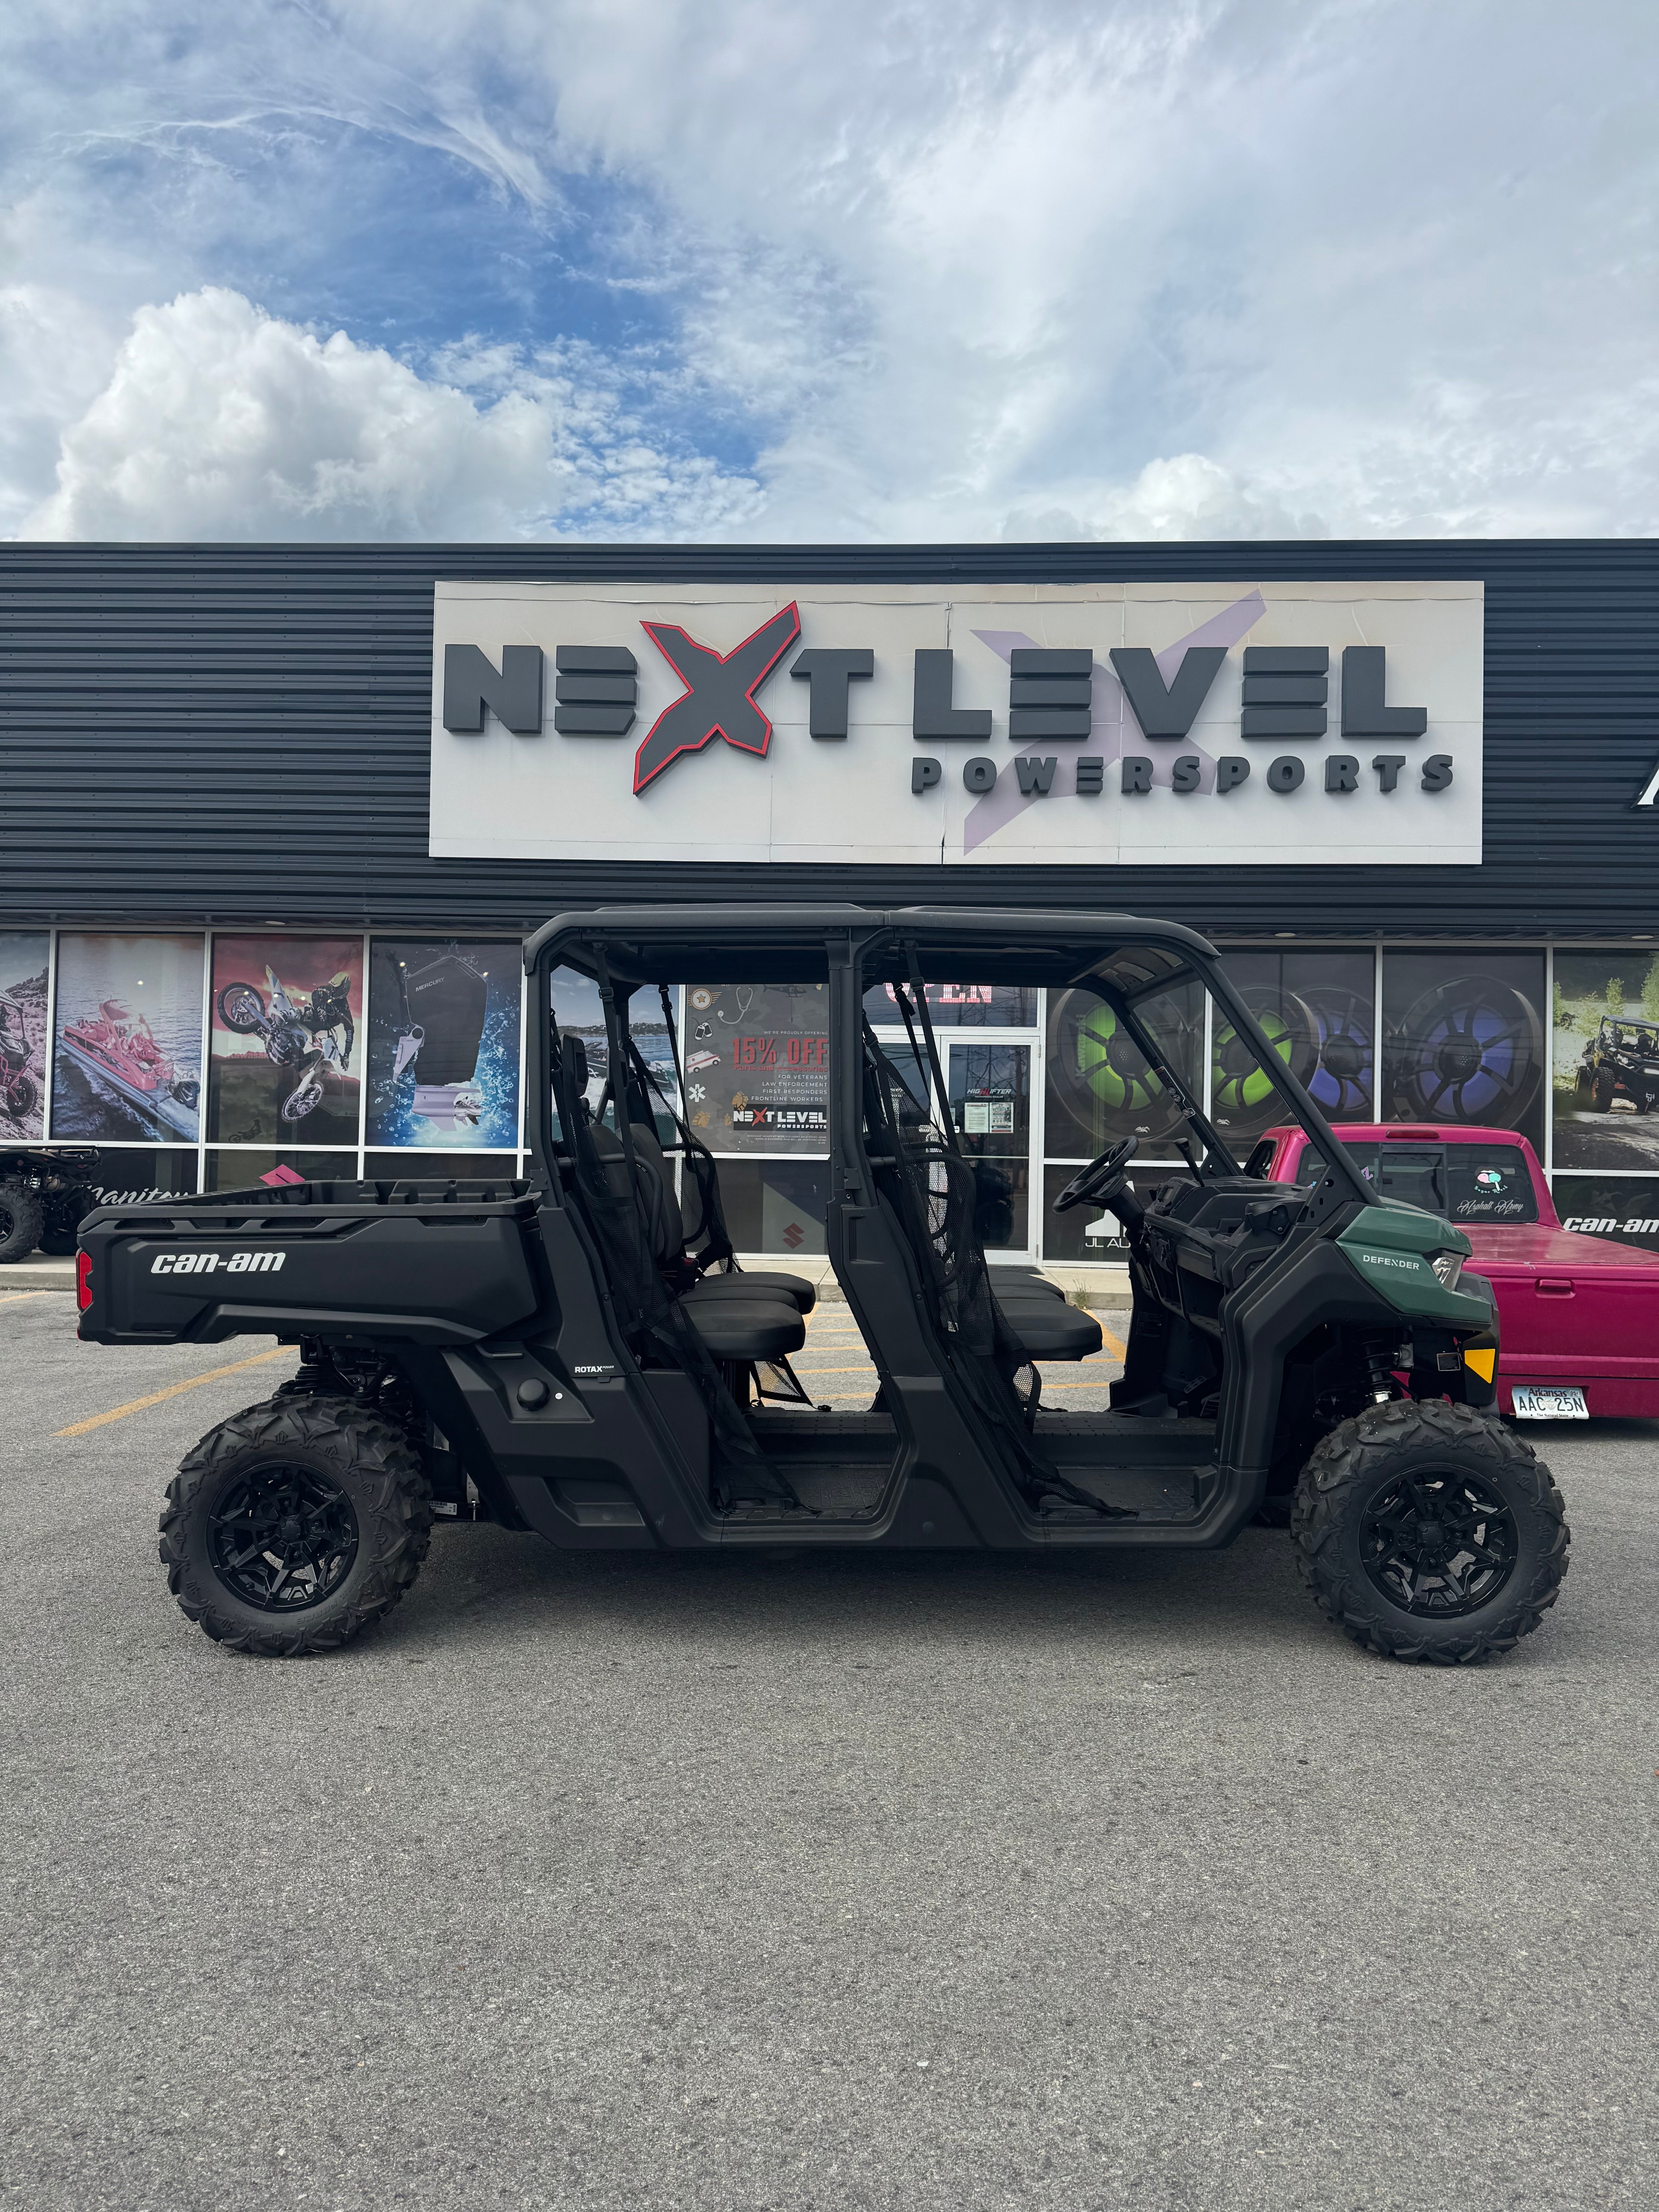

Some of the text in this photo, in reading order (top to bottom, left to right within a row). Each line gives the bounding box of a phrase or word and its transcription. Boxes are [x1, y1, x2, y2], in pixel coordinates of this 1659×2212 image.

[443, 600, 1427, 796] NEXT LEVEL
[912, 755, 1453, 793] POWERSPORTS
[416, 976, 445, 992] MERCURY
[732, 1037, 829, 1065] 15% OFF
[1075, 1014, 1086, 1077] Kawasaki
[733, 1106, 827, 1127] NEXT LEVEL
[1457, 1199, 1524, 1215] Asphalt Army
[1085, 1237, 1104, 1247] JL
[150, 1252, 286, 1274] can-am
[1363, 1255, 1420, 1271] DEFENDER
[1528, 1388, 1567, 1397] Arkansas
[1519, 1396, 1584, 1412] AAC 25N
